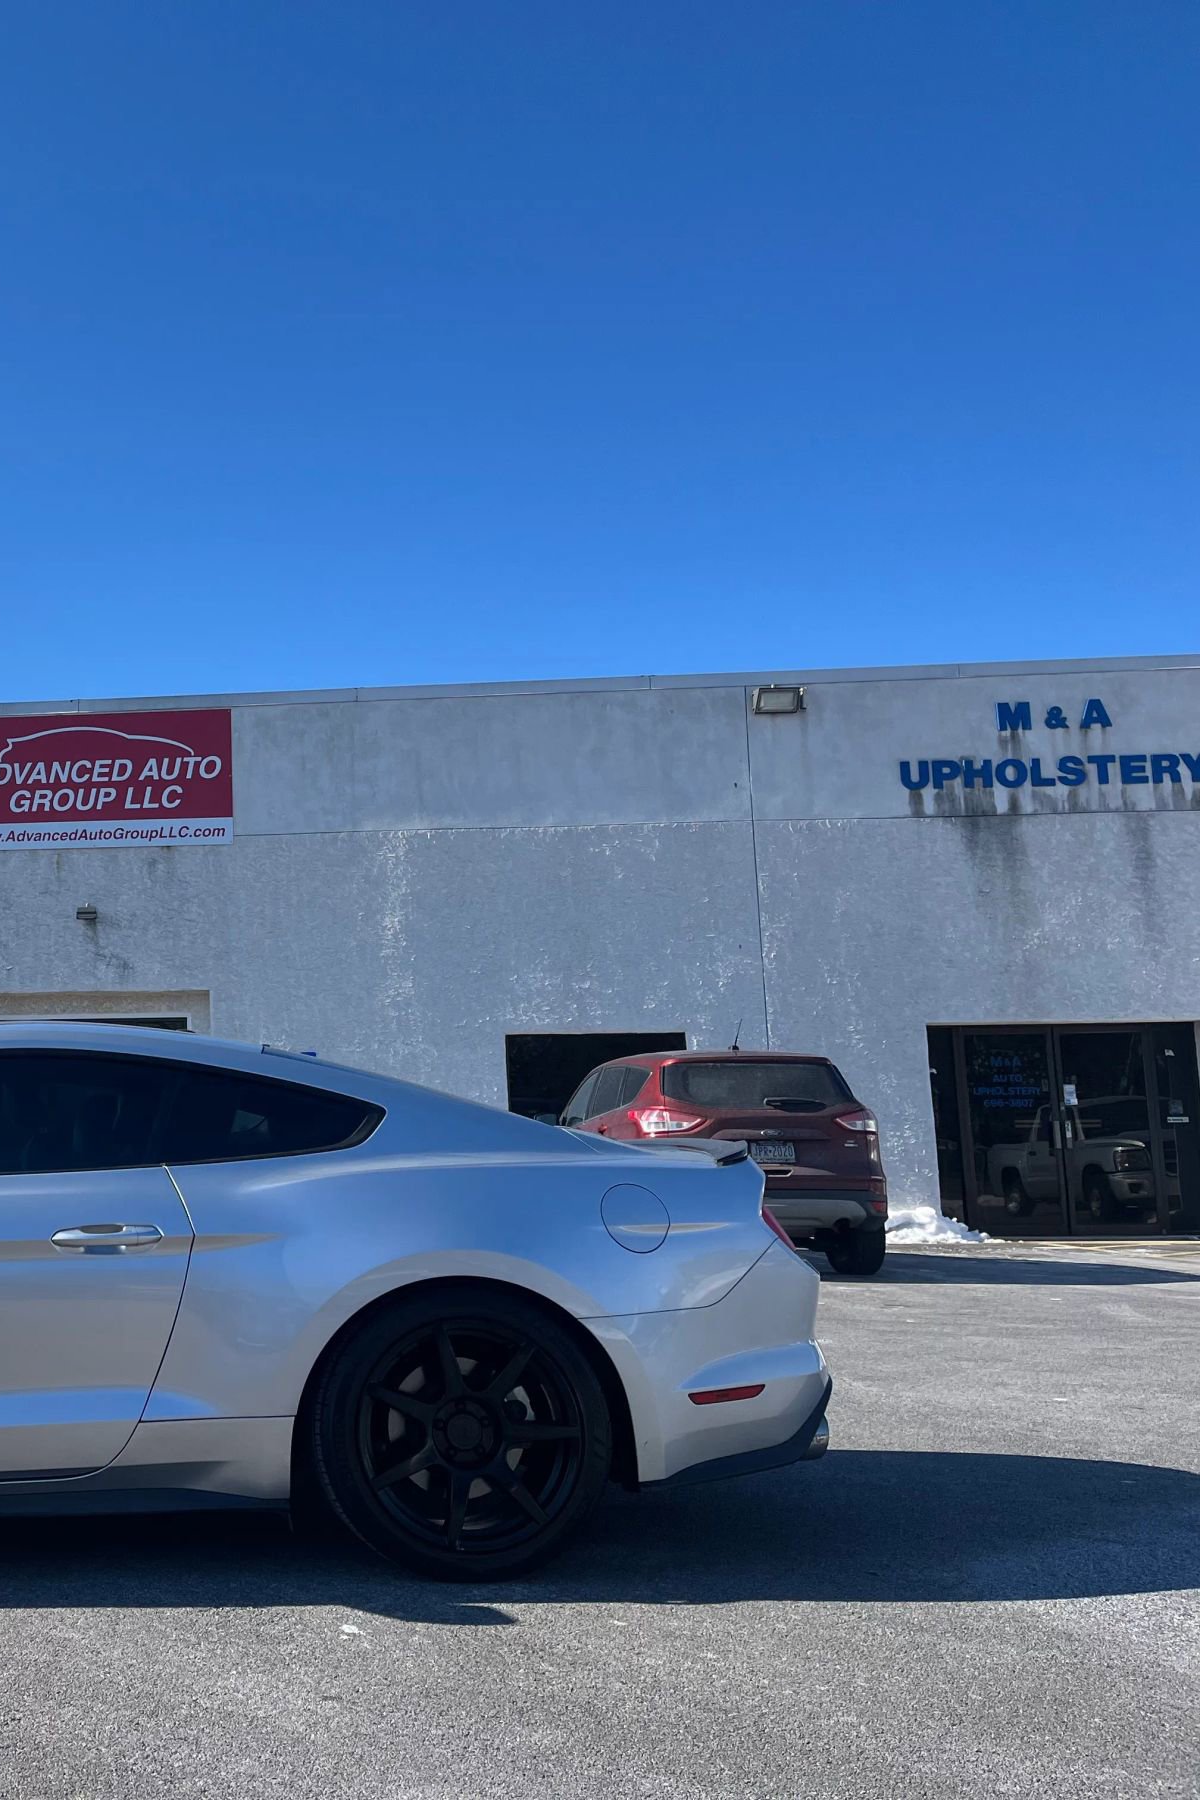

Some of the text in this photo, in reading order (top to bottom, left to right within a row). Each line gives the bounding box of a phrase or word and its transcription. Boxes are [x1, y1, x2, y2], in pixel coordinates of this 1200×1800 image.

[995, 698, 1113, 731] M & A
[138, 755, 222, 781] AUTO
[900, 752, 1200, 790] UPHOLSTERY
[9, 785, 183, 813] GROUP LLC
[992, 1074, 1023, 1083] AUTO
